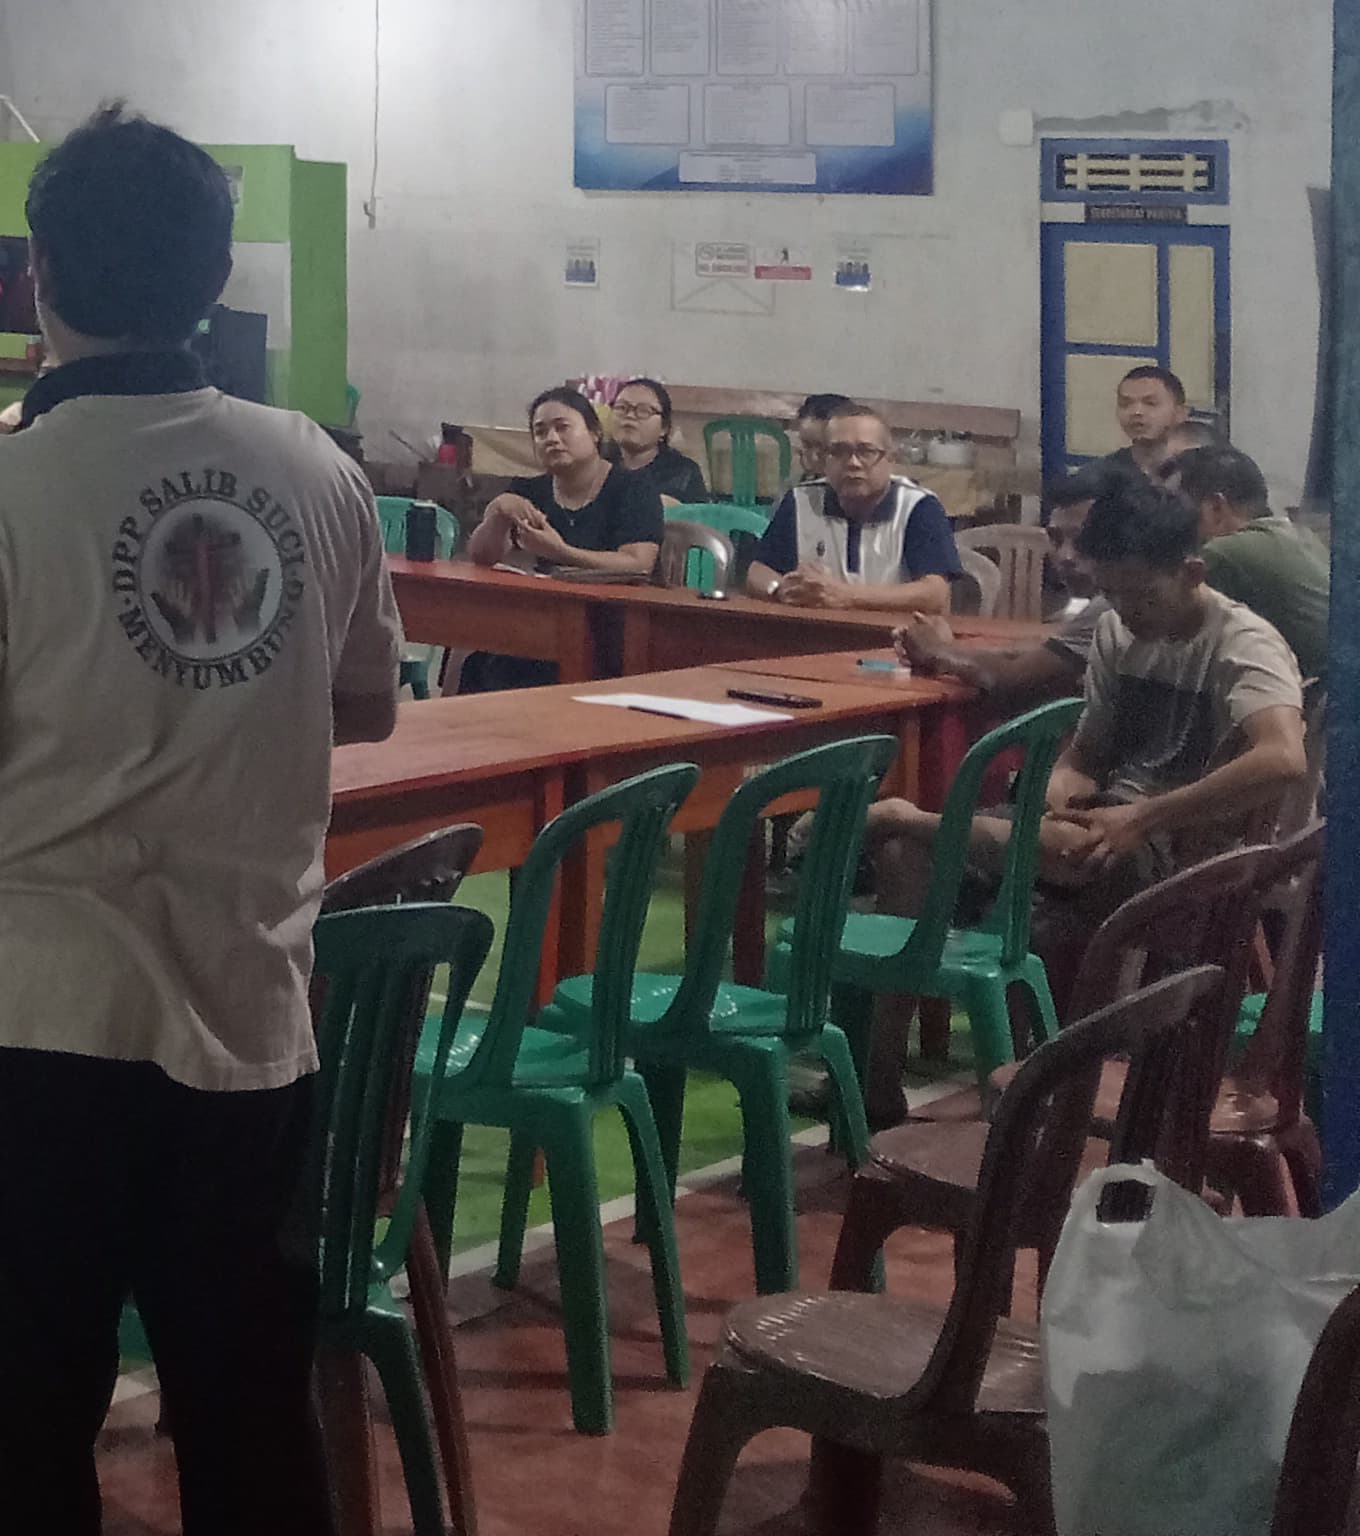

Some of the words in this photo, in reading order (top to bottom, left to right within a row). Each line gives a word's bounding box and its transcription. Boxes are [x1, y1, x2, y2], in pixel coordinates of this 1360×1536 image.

[112, 515, 145, 592] DPP
[139, 468, 238, 517] SALIB
[246, 486, 306, 564] SUCI
